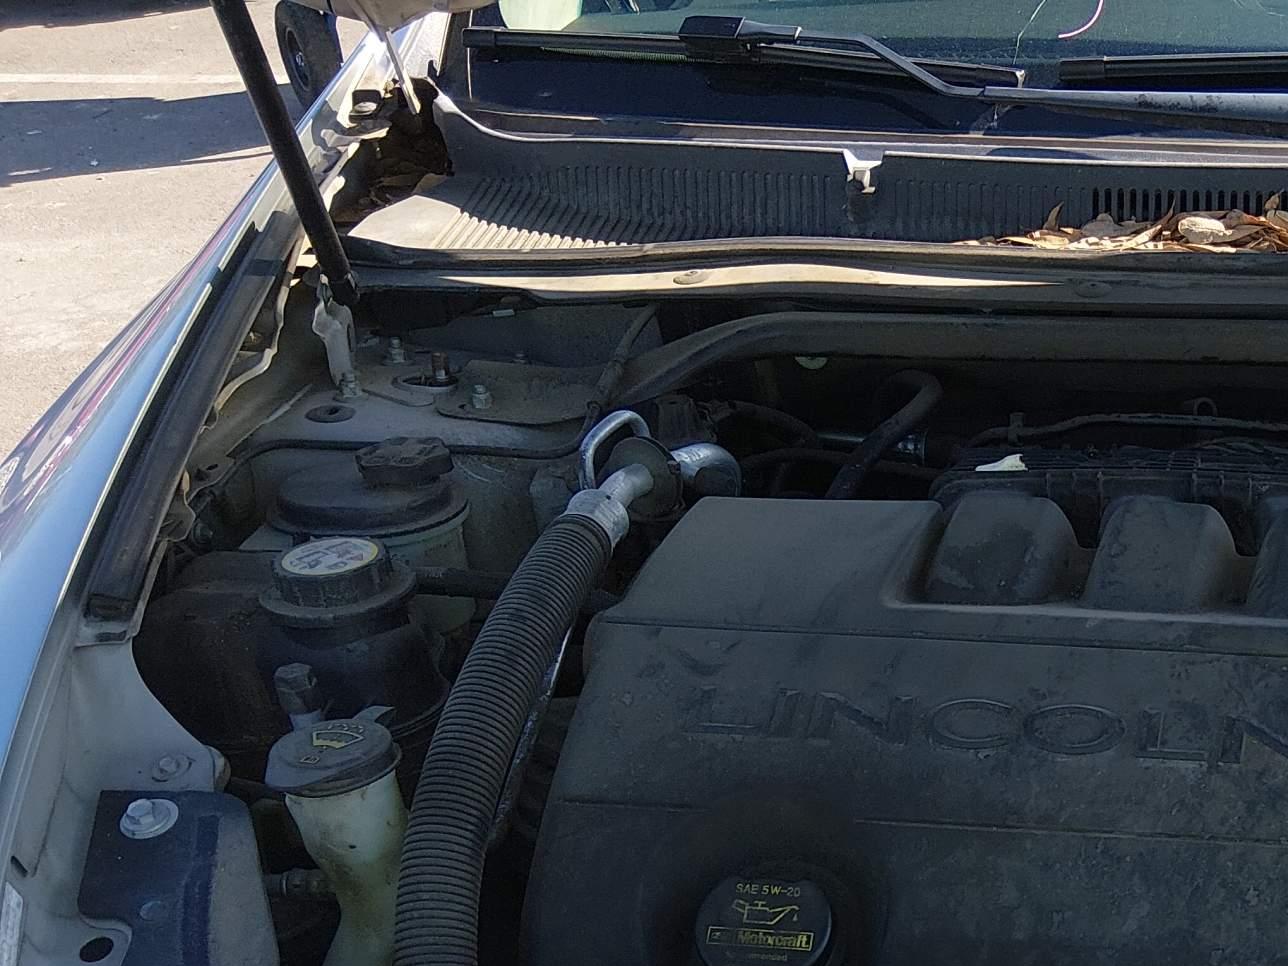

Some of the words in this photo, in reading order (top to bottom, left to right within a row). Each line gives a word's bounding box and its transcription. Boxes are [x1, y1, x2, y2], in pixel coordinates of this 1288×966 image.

[735, 882, 760, 895] SAE
[761, 884, 801, 898] 5W-20
[737, 930, 810, 949] Motorcraft
